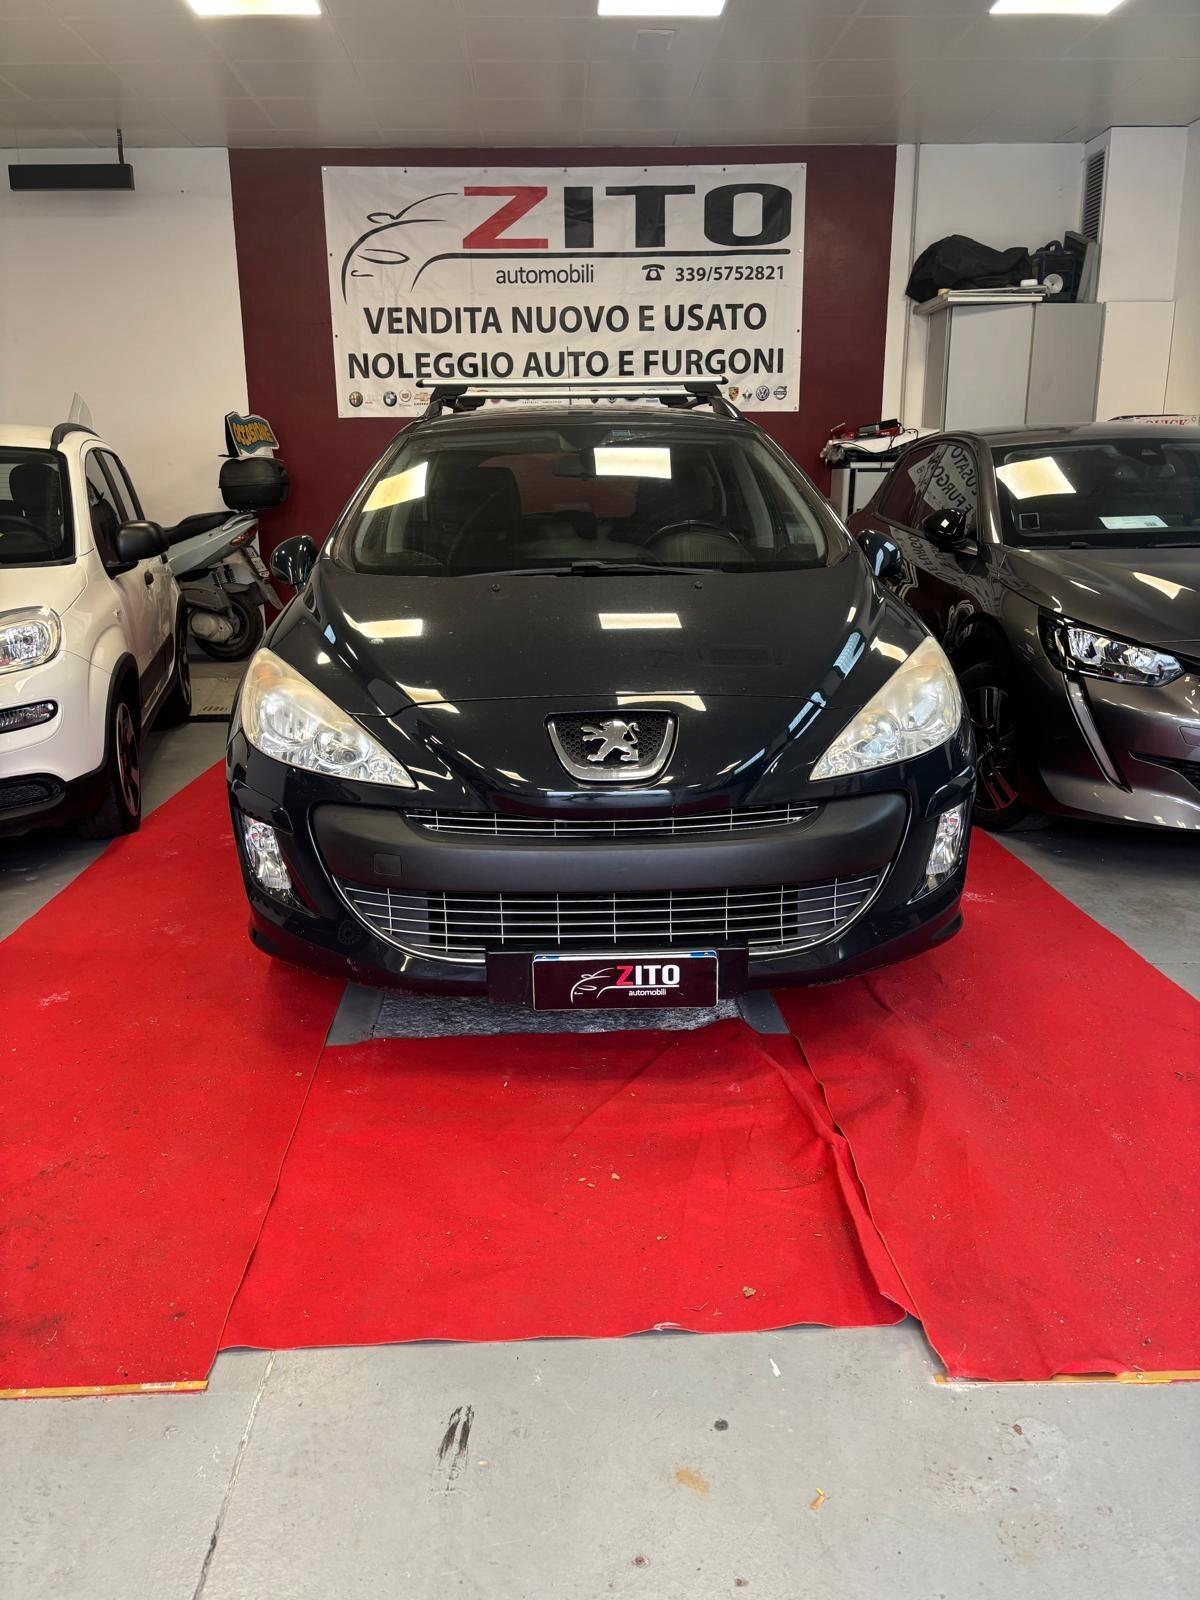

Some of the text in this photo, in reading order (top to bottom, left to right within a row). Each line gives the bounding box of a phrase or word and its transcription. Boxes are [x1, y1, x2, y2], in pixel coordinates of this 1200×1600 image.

[462, 183, 792, 250] ZITO
[496, 263, 594, 285] automobili
[675, 265, 784, 283] 339/5752821
[363, 302, 767, 335] VENDITA NUOVO E USATO
[348, 347, 784, 379] NOLEGGIO AUTO E FURGONI
[616, 964, 681, 986] ZITO
[628, 987, 667, 996] automobili
